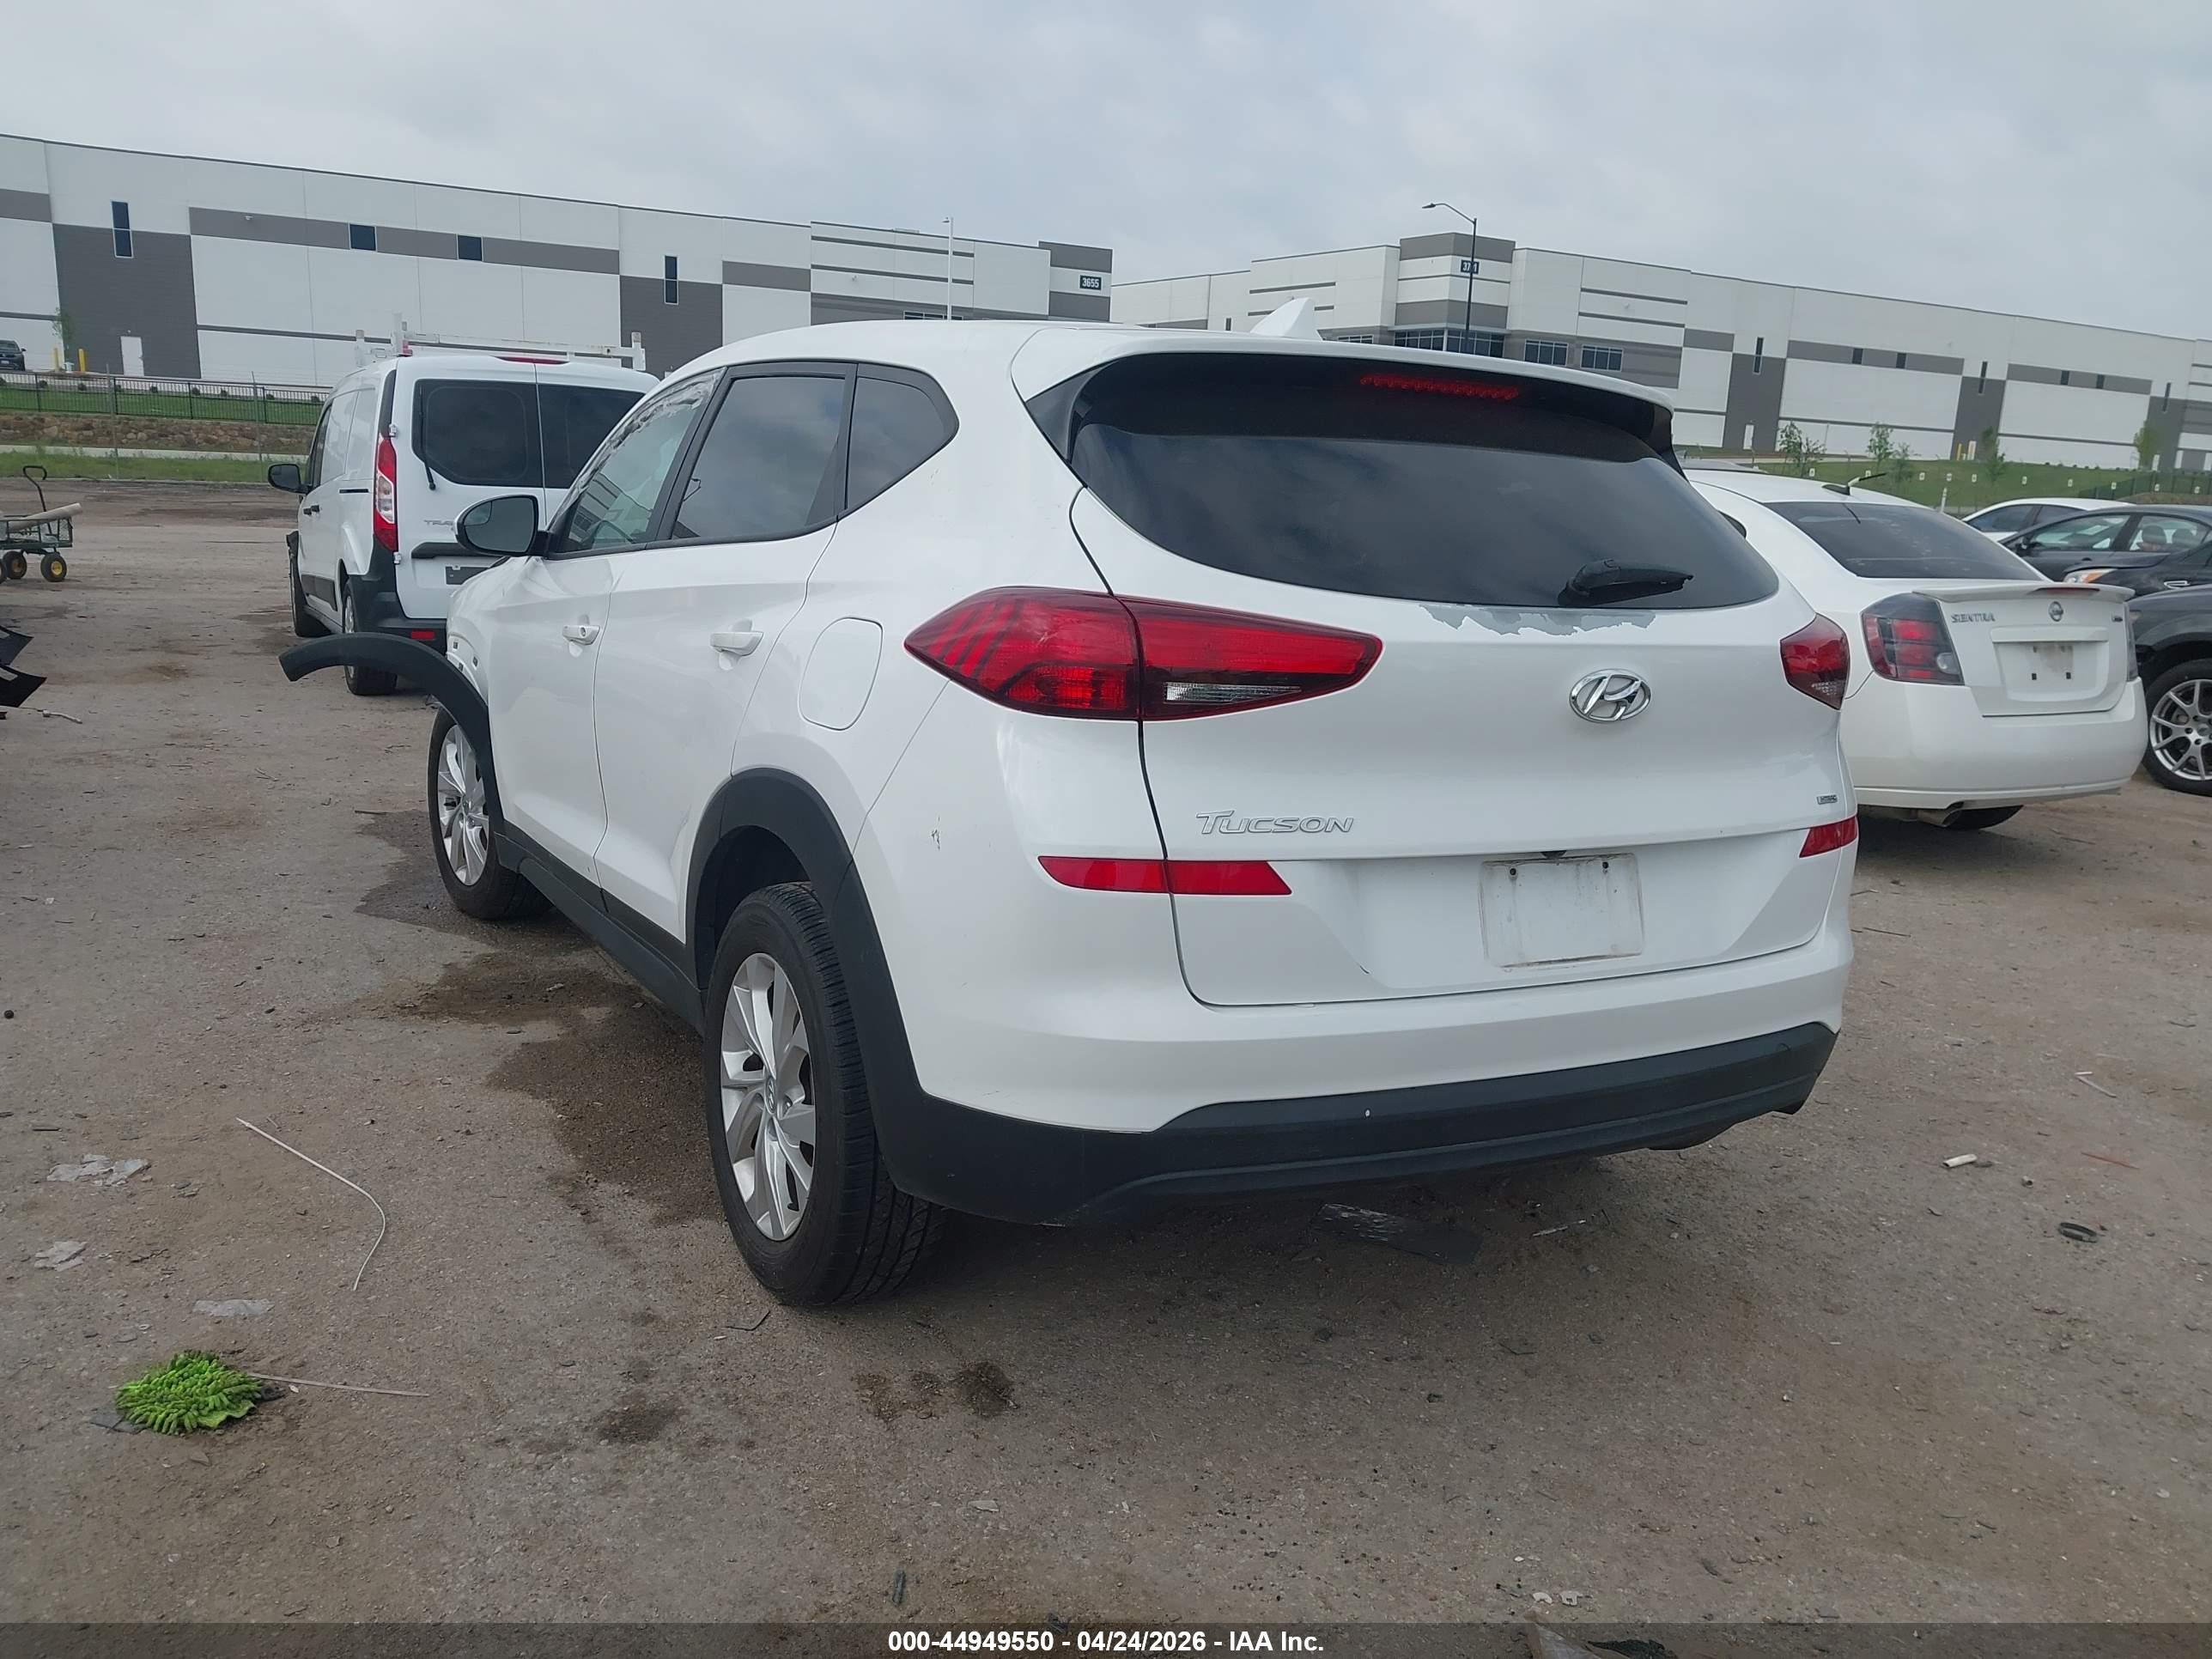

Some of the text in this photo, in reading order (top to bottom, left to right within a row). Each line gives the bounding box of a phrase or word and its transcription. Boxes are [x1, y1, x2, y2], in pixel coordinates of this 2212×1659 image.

[1462, 261, 1478, 272] 371
[1082, 277, 1099, 288] 3655
[1951, 612, 1996, 623] SENTRA
[1195, 810, 1354, 835] TUCSON
